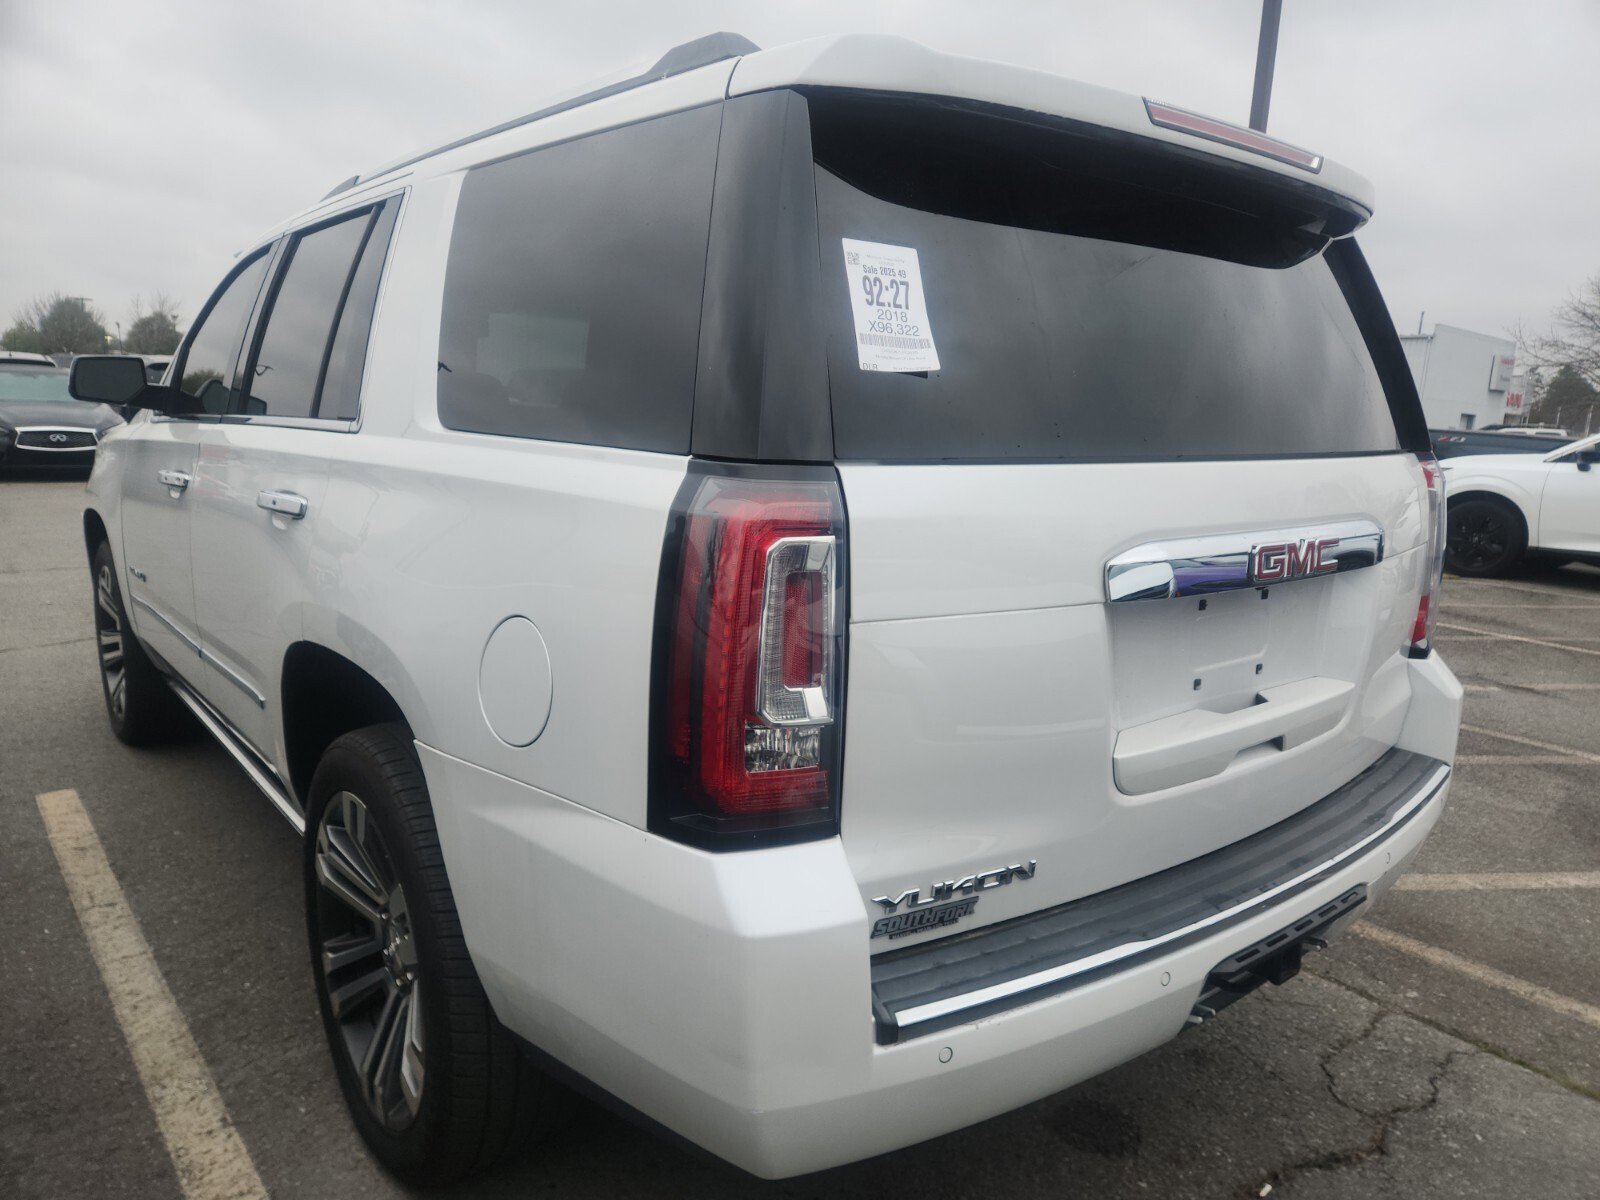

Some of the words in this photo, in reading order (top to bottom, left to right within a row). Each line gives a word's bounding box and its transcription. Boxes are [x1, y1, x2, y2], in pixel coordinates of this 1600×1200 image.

[862, 264, 878, 275] Sale
[868, 320, 920, 337] X96,322
[876, 309, 908, 323] 2018
[1253, 537, 1340, 582] GMC
[871, 859, 1037, 915] YUKON
[872, 900, 977, 938] SOUTHFORK
